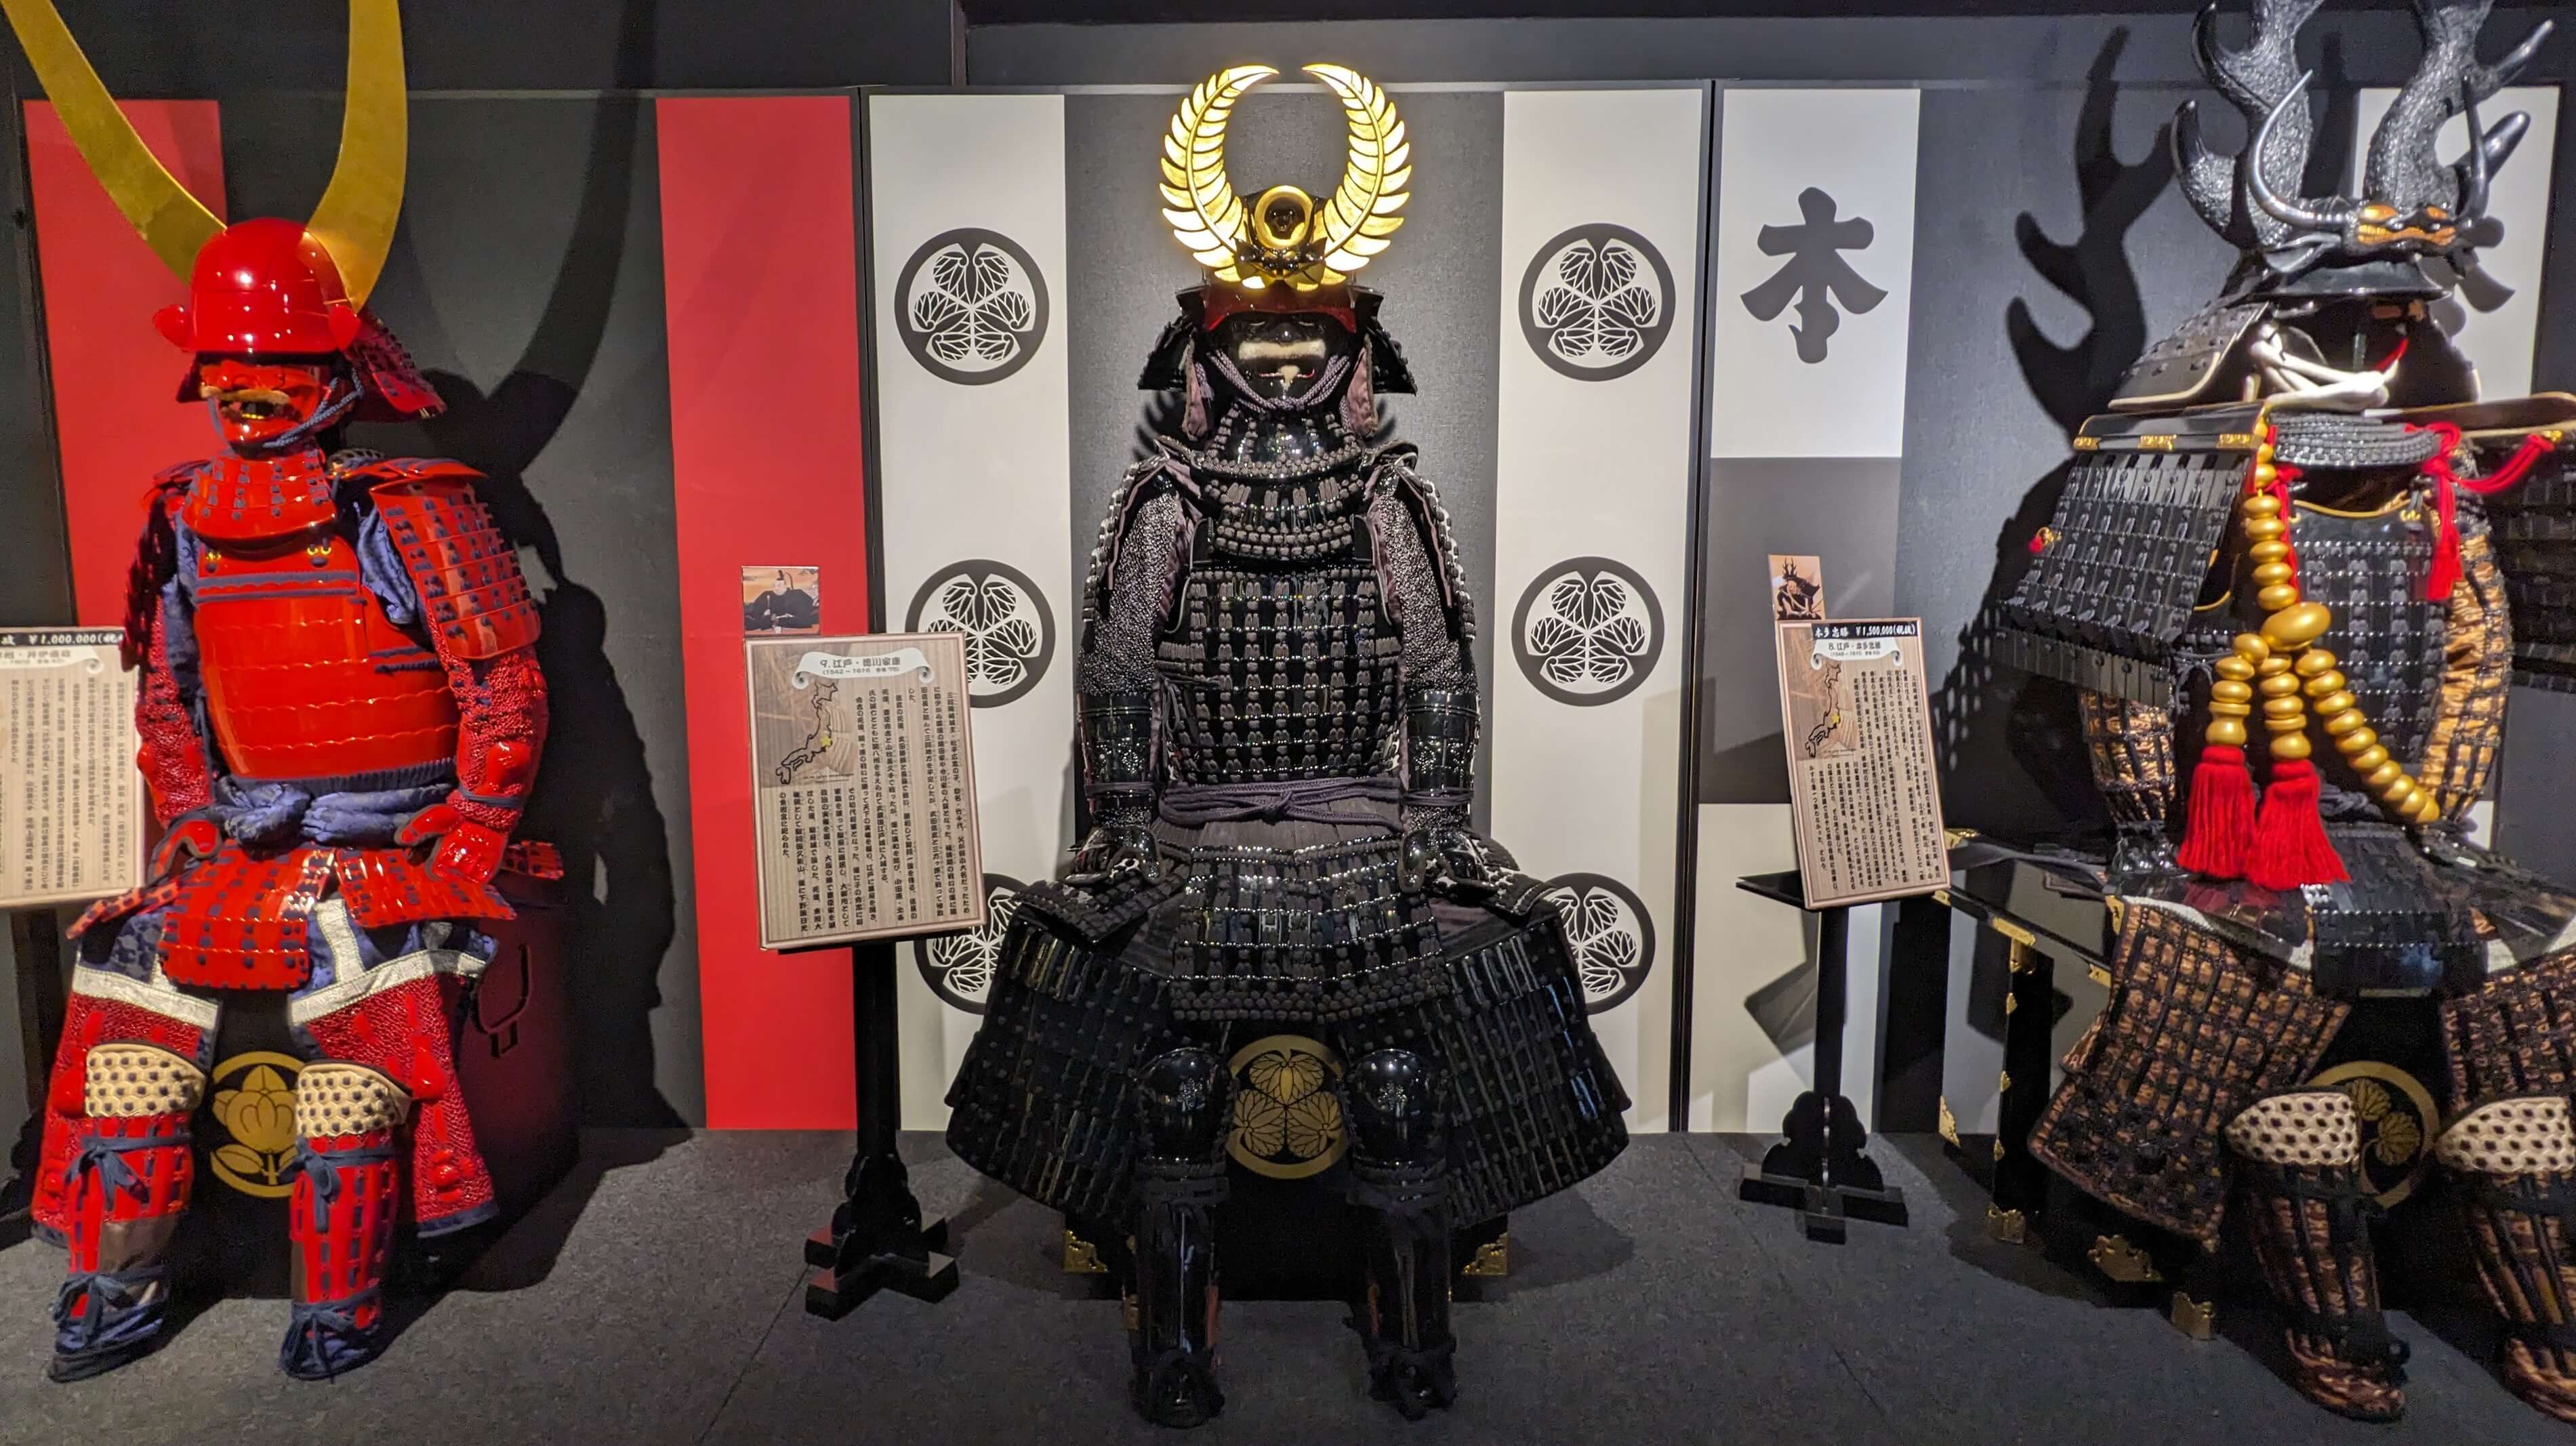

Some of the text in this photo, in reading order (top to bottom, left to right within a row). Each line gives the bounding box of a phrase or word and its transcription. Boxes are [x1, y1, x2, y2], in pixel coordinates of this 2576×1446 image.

[1814, 627, 1849, 638] 本多忠勝
[907, 688, 916, 702] した。
